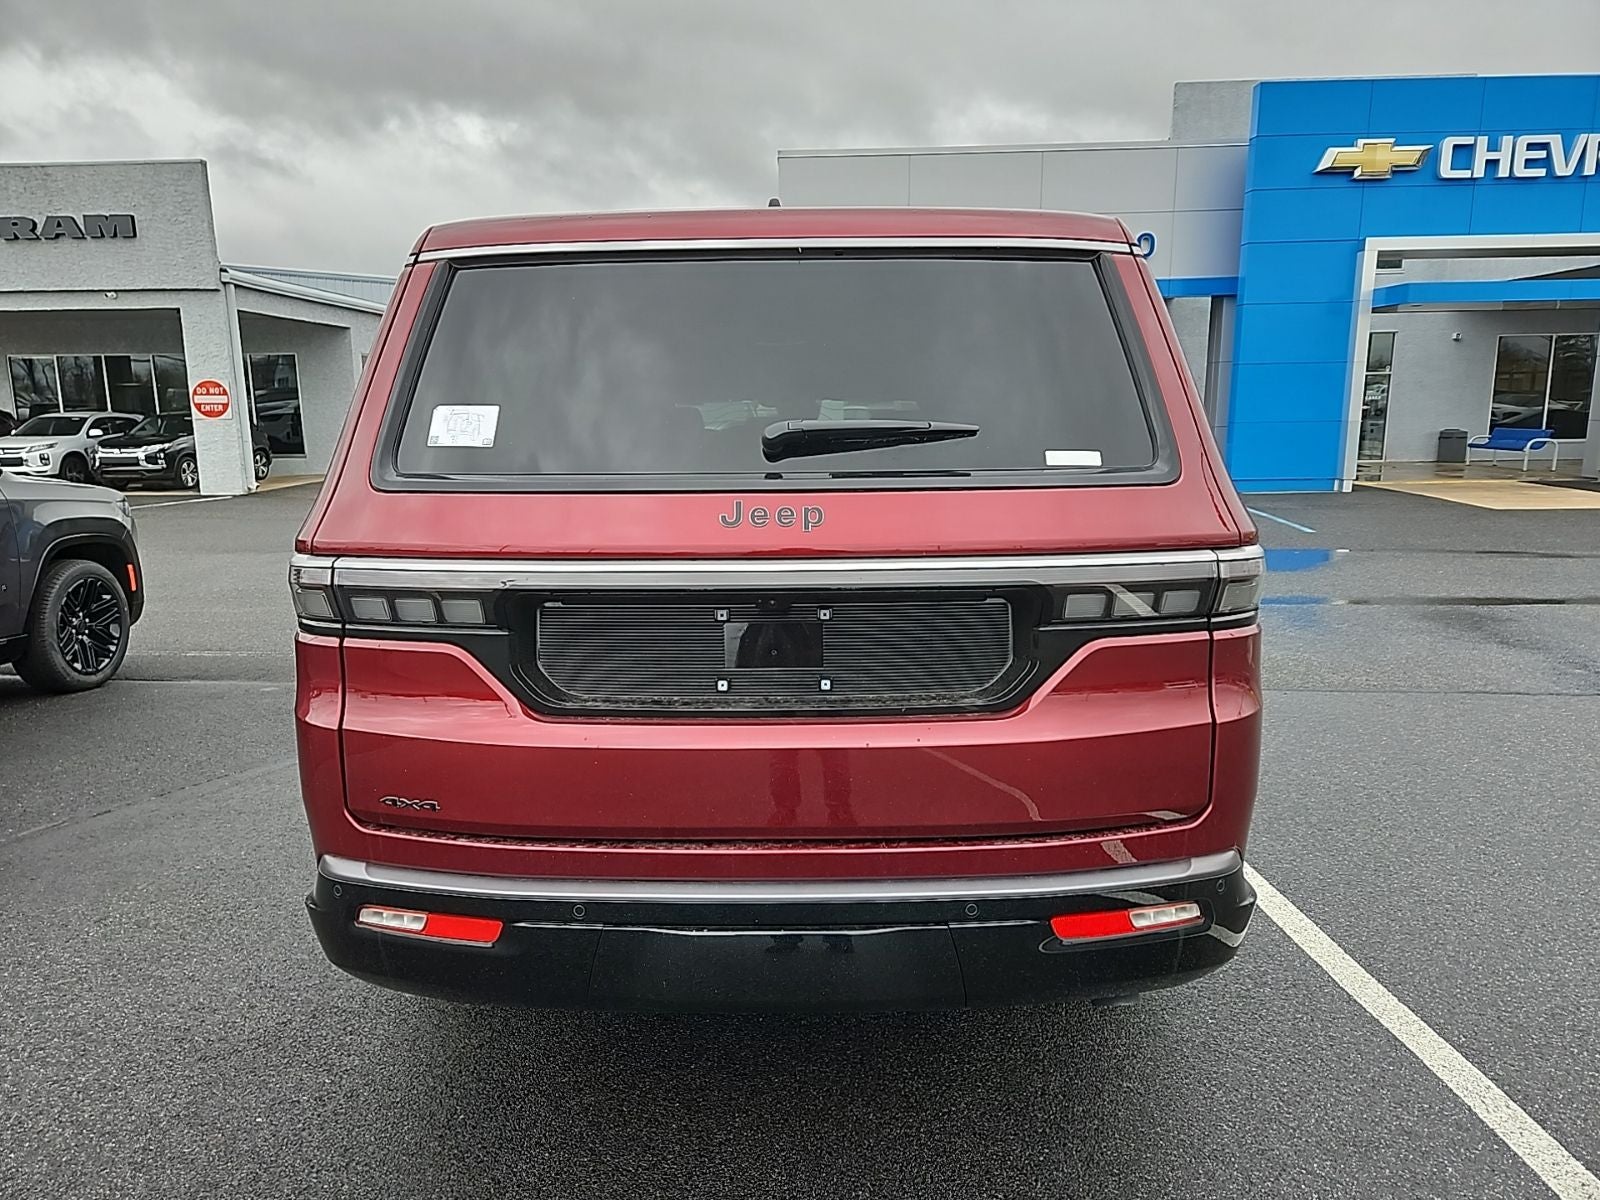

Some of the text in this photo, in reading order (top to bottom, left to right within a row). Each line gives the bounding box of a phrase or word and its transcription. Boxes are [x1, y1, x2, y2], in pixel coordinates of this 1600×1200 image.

[0, 214, 137, 240] RAM
[196, 387, 224, 395] DO NOT
[201, 404, 224, 412] ENTER
[719, 500, 825, 532] Jeep
